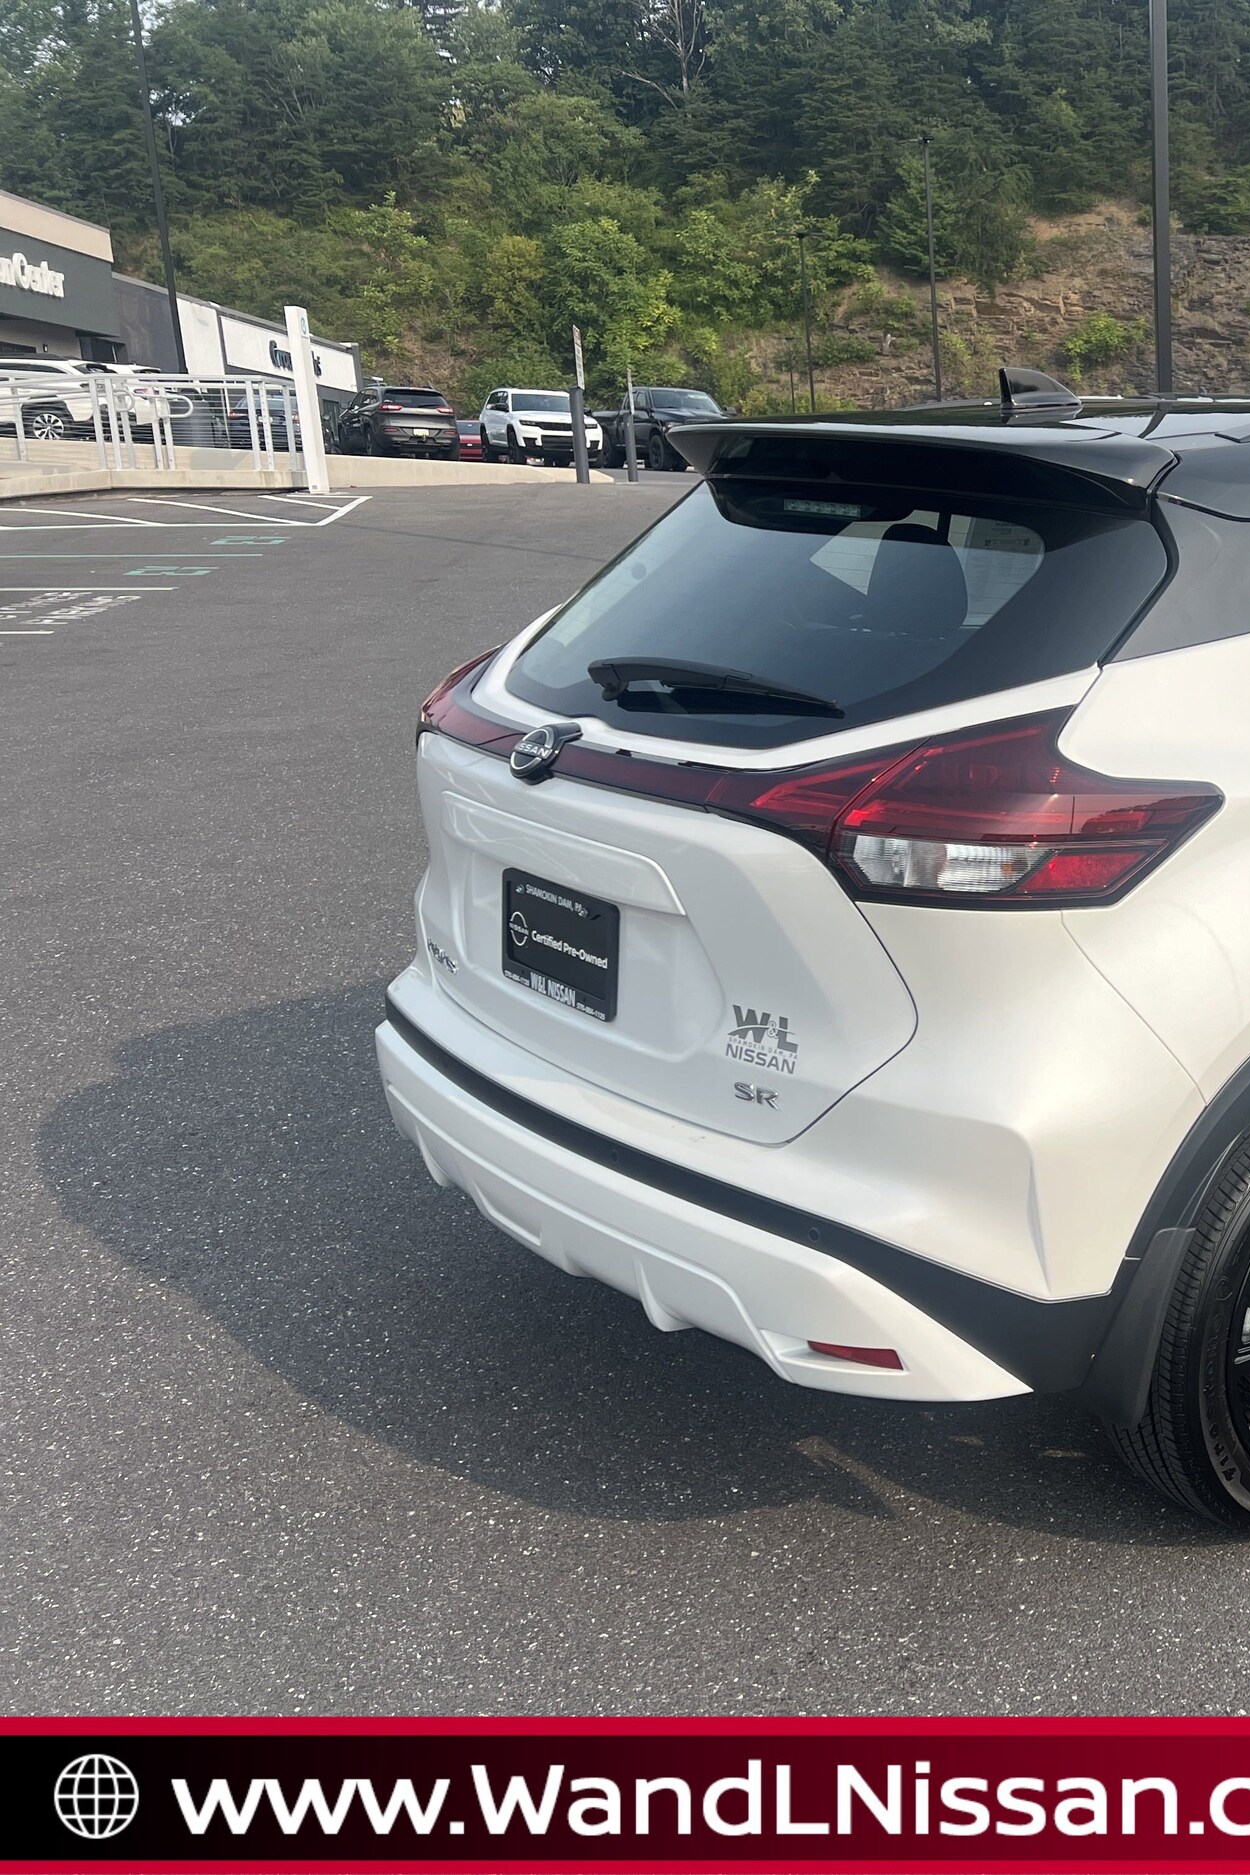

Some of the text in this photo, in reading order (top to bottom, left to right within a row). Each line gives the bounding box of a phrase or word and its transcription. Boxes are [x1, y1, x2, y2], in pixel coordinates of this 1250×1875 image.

[525, 883, 558, 904] SHAMOKIN
[558, 895, 574, 912] DAM,
[531, 930, 608, 969] Certified Pre-Owned
[530, 971, 576, 1007] W&L NISSAN
[728, 1004, 799, 1053] W&L
[728, 1036, 765, 1051] SHAMOKIN
[725, 1043, 796, 1074] NISSAN
[734, 1081, 780, 1111] SR
